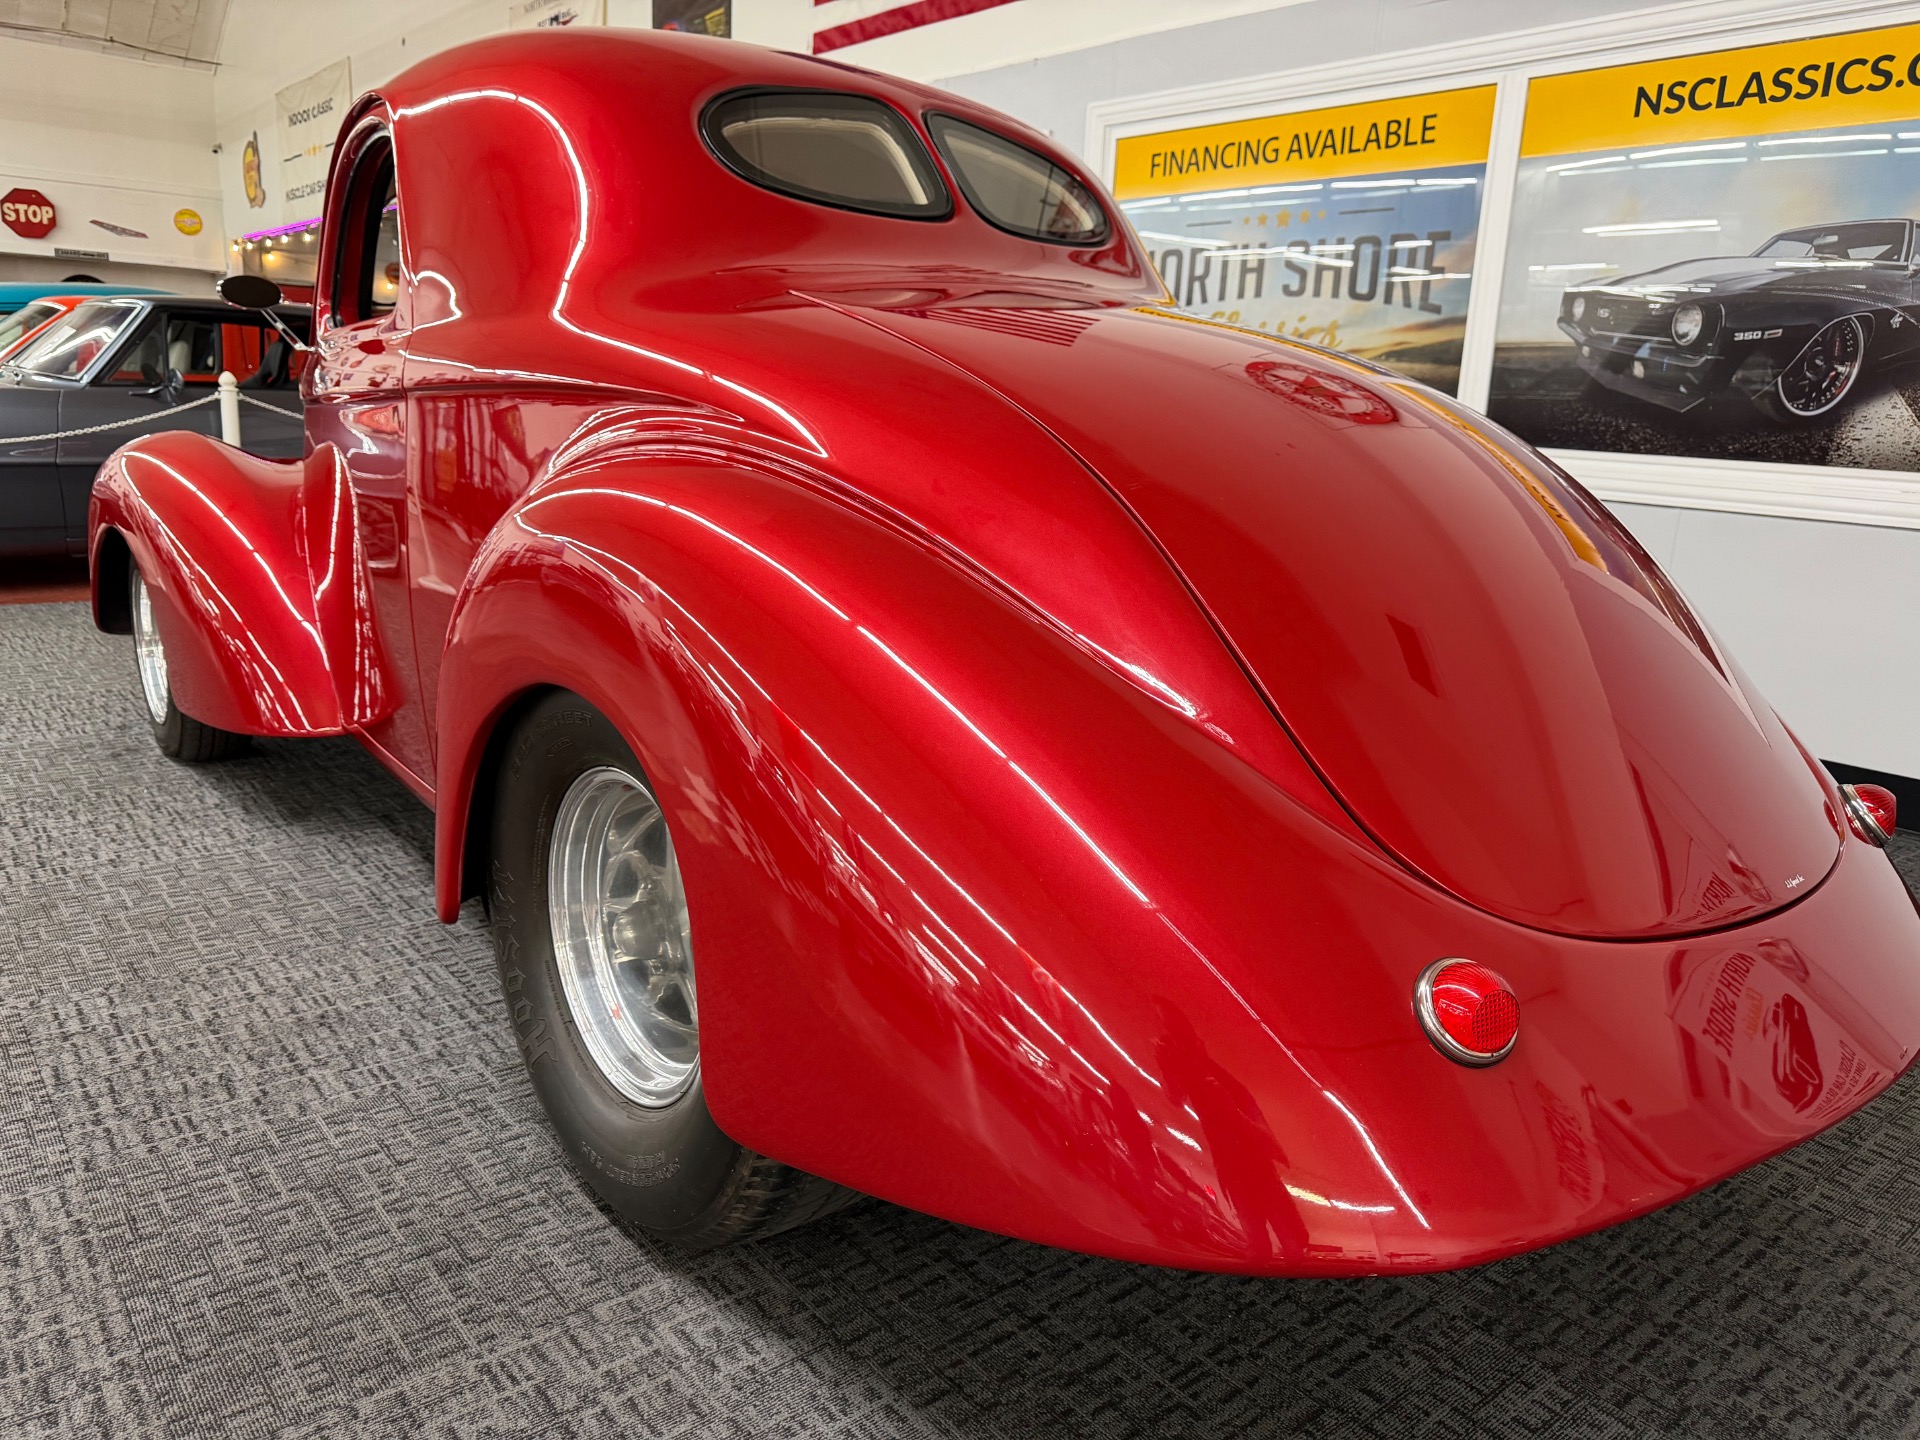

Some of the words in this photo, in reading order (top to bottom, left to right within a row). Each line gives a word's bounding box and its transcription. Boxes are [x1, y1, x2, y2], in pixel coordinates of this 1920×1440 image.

[1150, 136, 1280, 178] FINANCING
[1286, 113, 1438, 161] AVAILABLE
[2, 202, 53, 225] STOP
[1282, 230, 1452, 315] SHORE
[1734, 330, 1762, 341] 350
